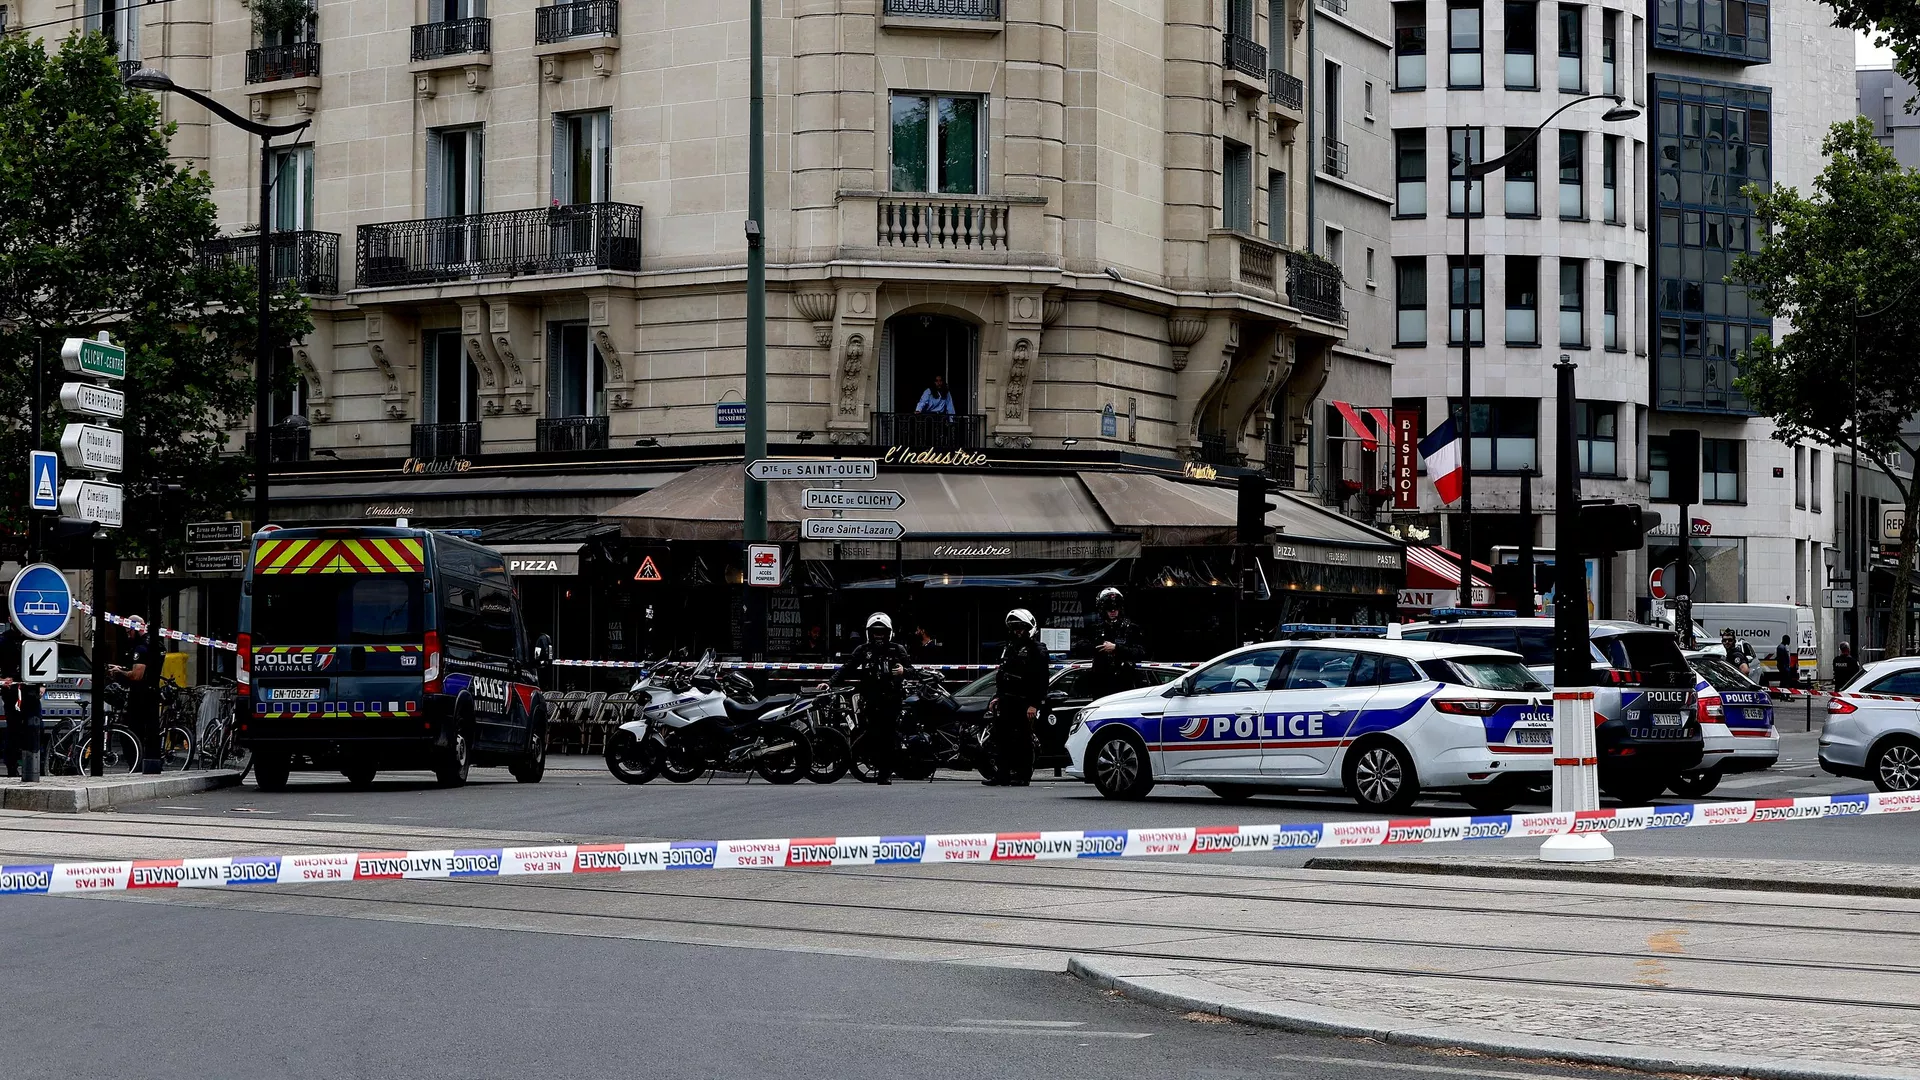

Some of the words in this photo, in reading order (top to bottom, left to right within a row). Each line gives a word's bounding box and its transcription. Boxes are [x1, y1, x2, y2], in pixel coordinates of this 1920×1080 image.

[84, 389, 122, 411] PÉRIPHÉRIQUE
[718, 413, 746, 422] BESSIÈRES
[86, 431, 105, 447] Tribunal
[105, 435, 111, 448] de
[86, 448, 102, 462] Grande
[102, 451, 121, 466] Instance
[1400, 419, 1411, 502] BISTROT
[797, 464, 870, 475] SAINT-OUEN
[87, 488, 109, 503] Cimetière
[811, 495, 844, 505] PLACE
[857, 495, 893, 505] CLICHY
[87, 505, 95, 518] des
[96, 505, 121, 522] Batignolles
[812, 524, 834, 534] Gare
[837, 524, 894, 535] Saint-Lazare
[1693, 524, 1711, 533] SNCF
[827, 546, 871, 556] BASSERIE
[933, 544, 1012, 557] l'Industrie
[1067, 546, 1115, 556] RESTAURANT
[1277, 546, 1297, 557] PIZZA
[1377, 555, 1396, 565] PASTA
[510, 561, 558, 571] PIZZA
[771, 597, 801, 610] PIZZA
[1051, 600, 1083, 613] PIZZA
[772, 610, 802, 624] PASTA
[254, 654, 313, 665] POLICE
[473, 676, 504, 700] POLICE
[1647, 691, 1682, 702] POLICE
[1726, 693, 1752, 703] POLICE
[474, 699, 503, 715] NATIONALE
[1520, 712, 1551, 721] POLICE
[1213, 714, 1324, 739] POLICE
[1755, 805, 1821, 821] NATIONALE
[1823, 801, 1866, 816] POLICE
[1521, 817, 1568, 828] FRANCHIR
[1576, 817, 1643, 832] NATIONALE
[1646, 812, 1690, 827] POLICE
[1332, 826, 1381, 837] FRANCHIR
[1389, 826, 1459, 841] NATIONALE
[1462, 822, 1508, 837] POLICE
[936, 838, 987, 848] FRANCHIR
[1138, 832, 1188, 843] FRANCHIR
[1196, 833, 1269, 850] NATIONALE
[1272, 830, 1319, 846] POLICE
[1339, 838, 1355, 846] PAS
[1355, 837, 1373, 845] NE
[729, 843, 781, 854] FRANCHIR
[871, 841, 922, 858] POLICE
[998, 839, 1072, 857] NATIONALE
[1075, 836, 1125, 852] POLICE
[1145, 844, 1163, 853] PAS
[1164, 843, 1180, 852] NE
[514, 850, 568, 860] FRANCHIR
[579, 850, 659, 867] NATIONALE
[662, 848, 713, 864] POLICE
[791, 845, 869, 862] NATIONALE
[945, 850, 964, 860] PAS
[965, 849, 980, 859] NE
[293, 857, 349, 868] FRANCHIR
[446, 854, 499, 871] POLICE
[737, 856, 759, 866] PAS
[759, 855, 774, 865] NE
[65, 866, 122, 877] FRANCHIR
[222, 862, 277, 880] POLICE
[359, 857, 444, 875] NATIONALE
[523, 862, 545, 872] PAS
[546, 861, 562, 871] NE
[134, 865, 219, 883] NATIONALE
[302, 869, 326, 879] PAS
[326, 868, 342, 878] NE
[0, 872, 48, 891] POLIC
[75, 878, 98, 889] PAS
[99, 877, 115, 888] NE
